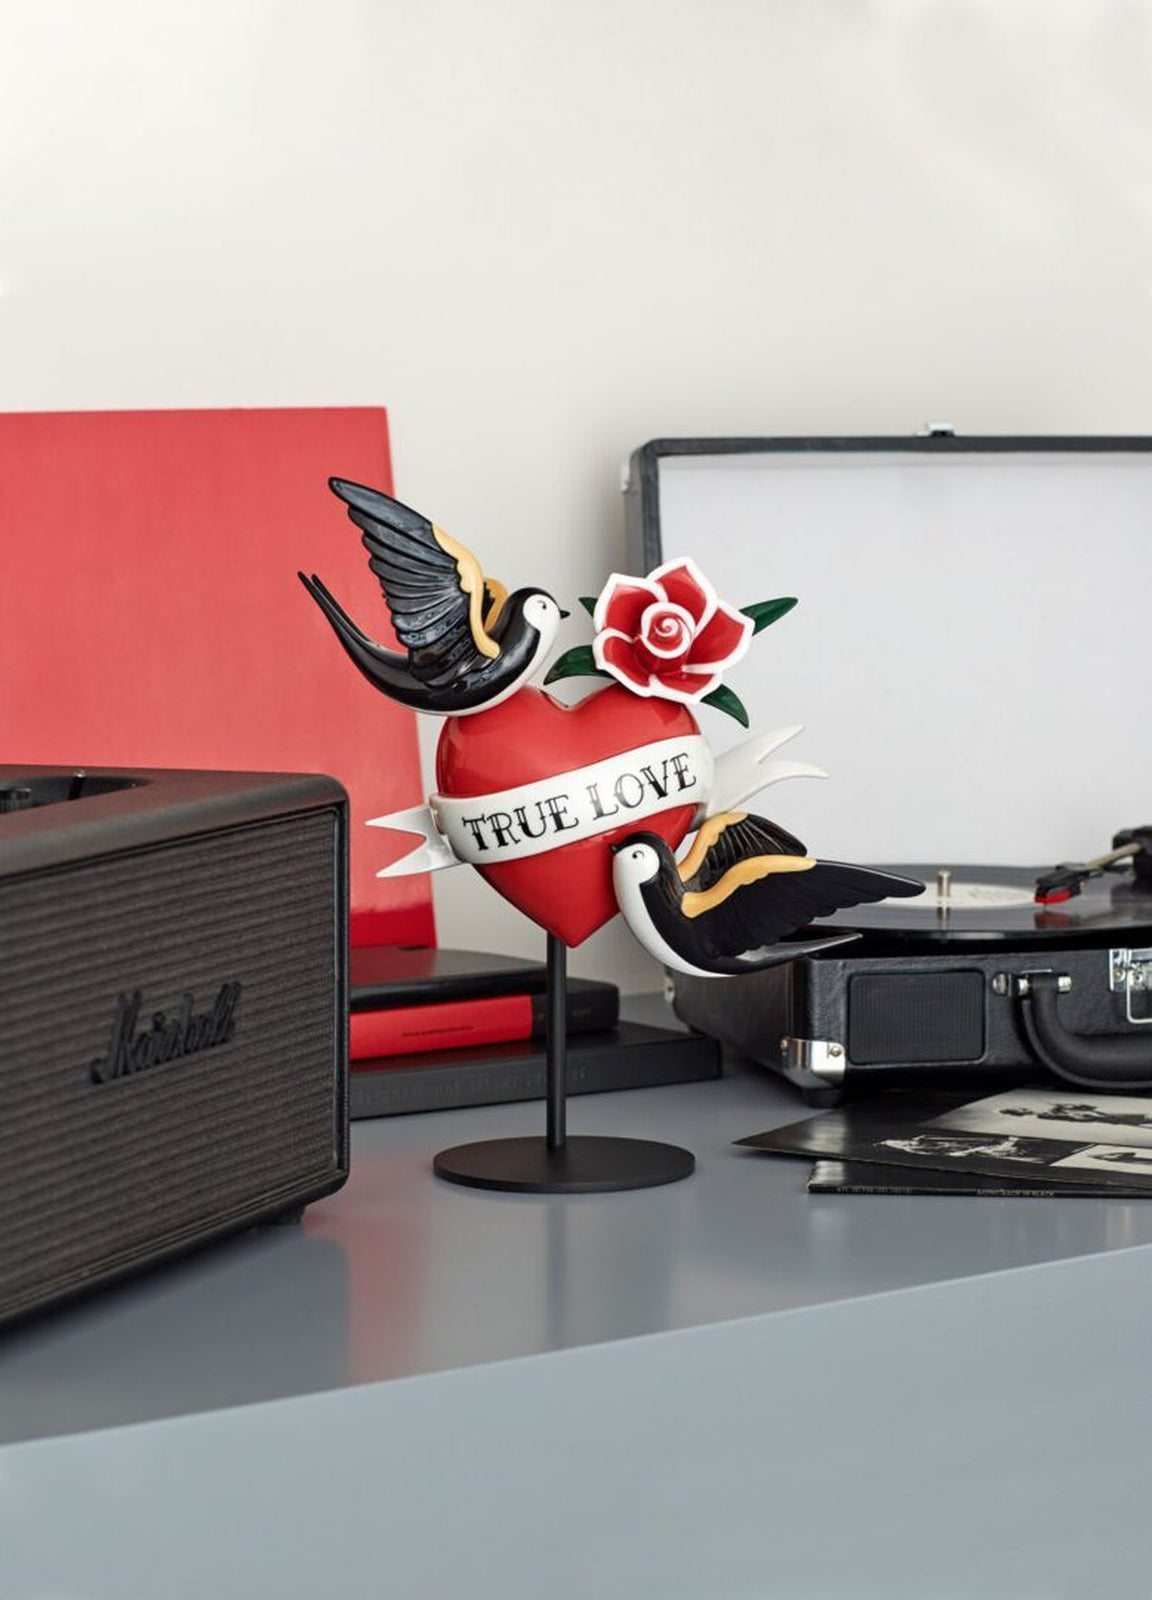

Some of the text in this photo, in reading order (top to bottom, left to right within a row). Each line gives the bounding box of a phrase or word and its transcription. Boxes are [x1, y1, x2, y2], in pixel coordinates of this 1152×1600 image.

[462, 753, 697, 851] TRUE LOVE
[89, 980, 242, 1085] Marshall
